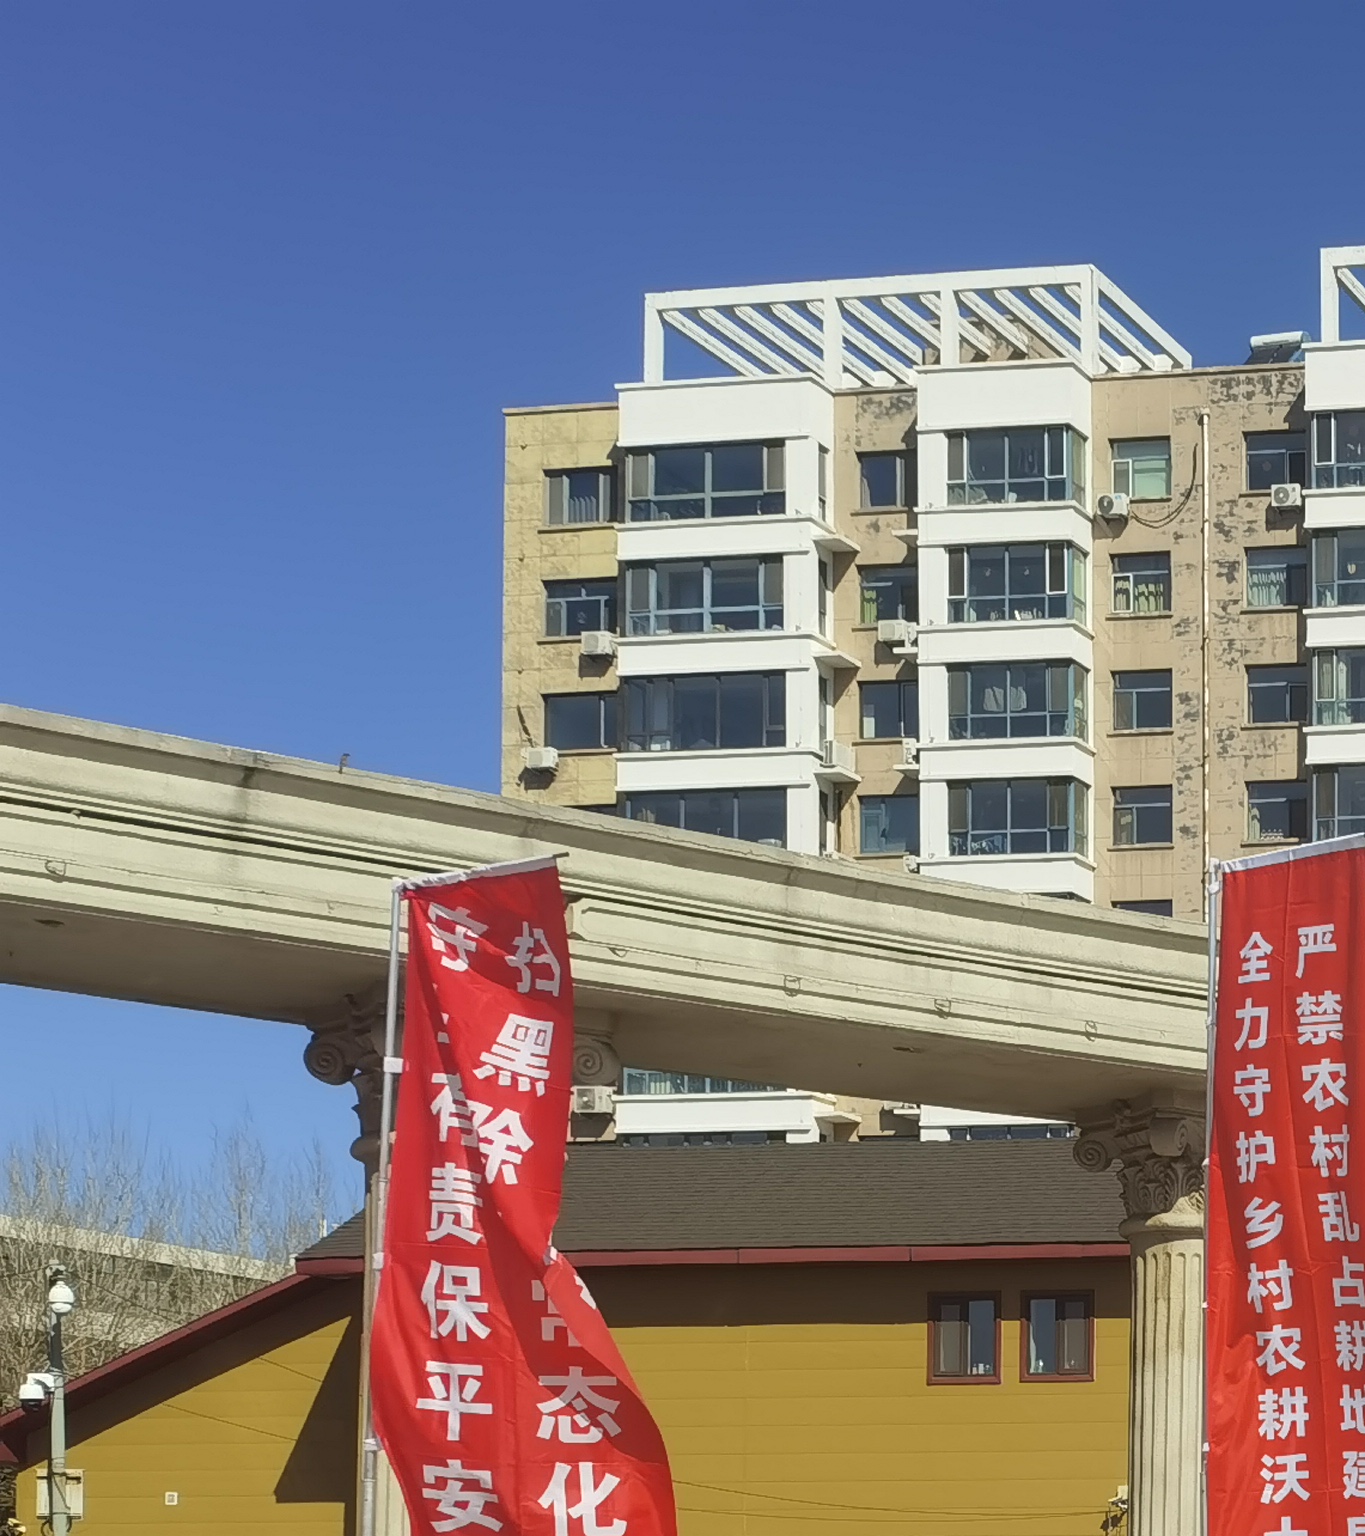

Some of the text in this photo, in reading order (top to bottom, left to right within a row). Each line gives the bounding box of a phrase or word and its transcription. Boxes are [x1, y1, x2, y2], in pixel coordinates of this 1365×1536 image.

[415, 900, 504, 1534] 守有责保平安
